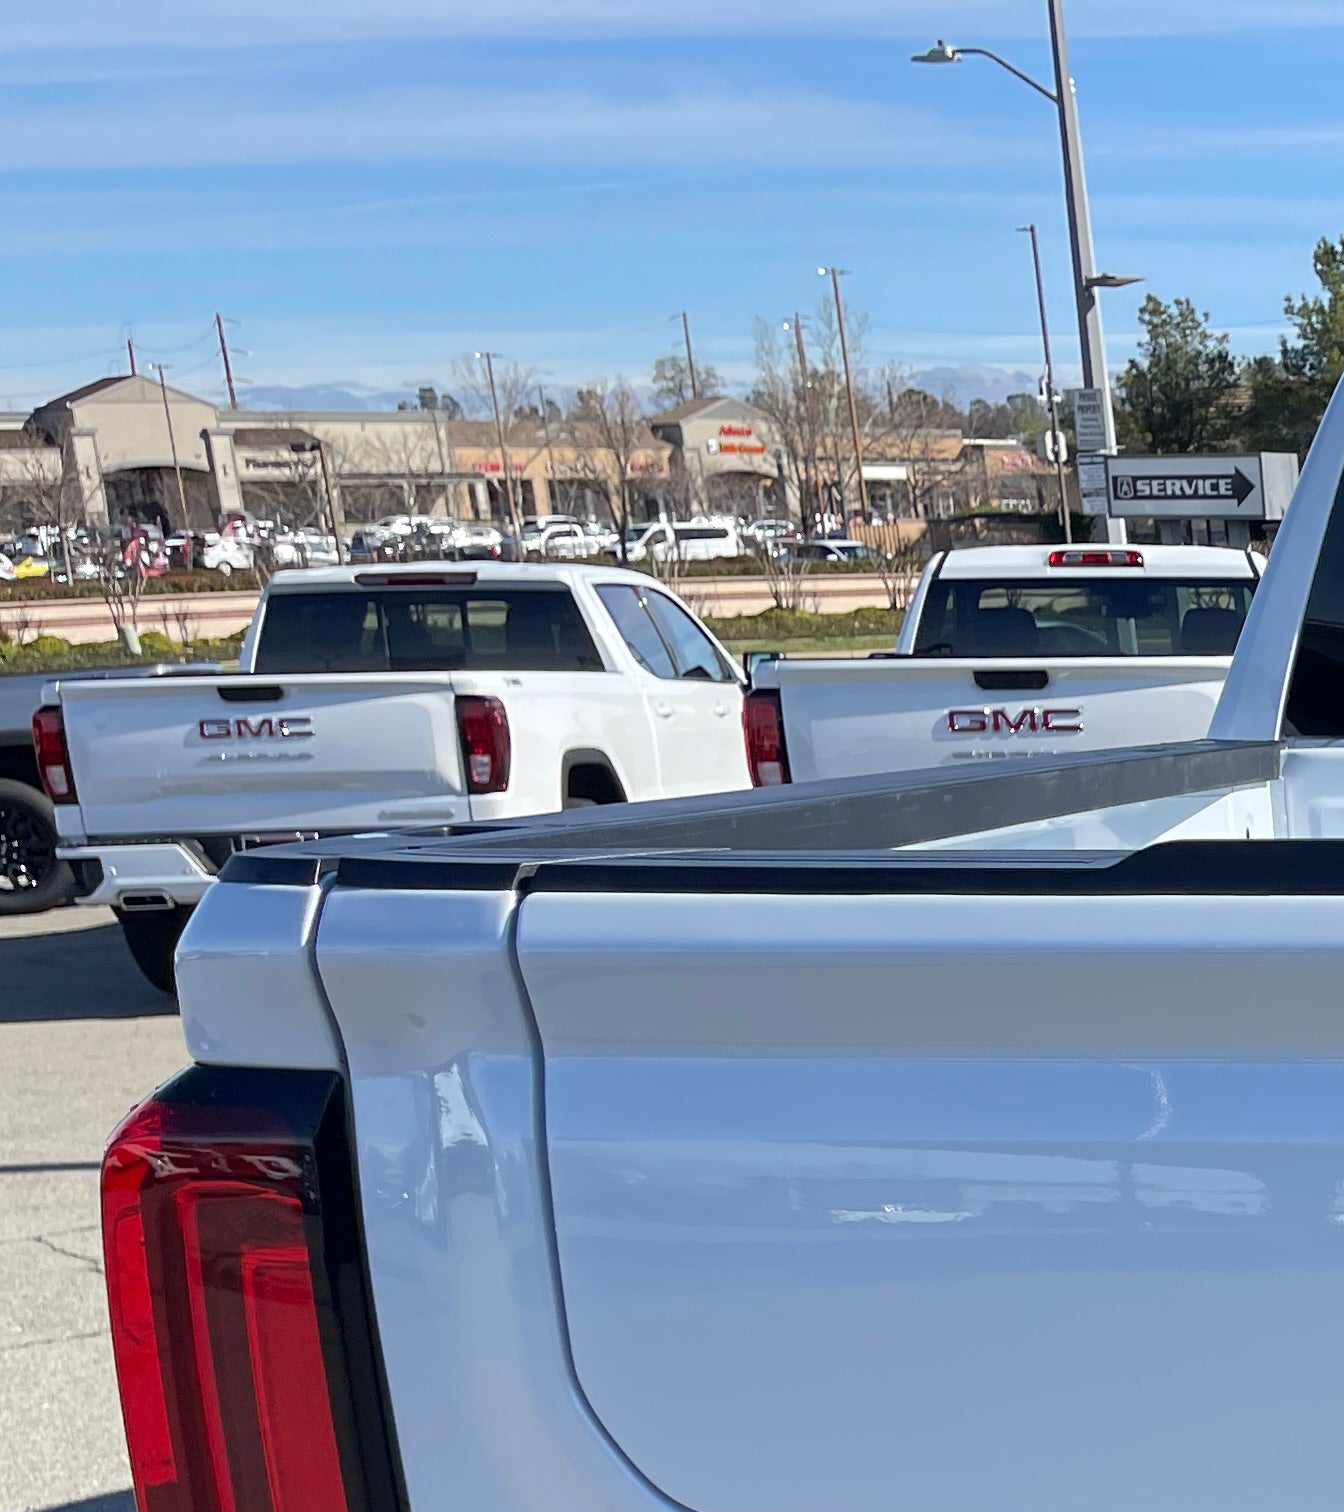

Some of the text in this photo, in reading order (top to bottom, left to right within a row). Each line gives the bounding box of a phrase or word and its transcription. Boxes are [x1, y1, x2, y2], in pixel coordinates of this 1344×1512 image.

[1136, 478, 1233, 496] SERVICE
[199, 718, 315, 738] GMC
[947, 708, 1084, 734] GMC
